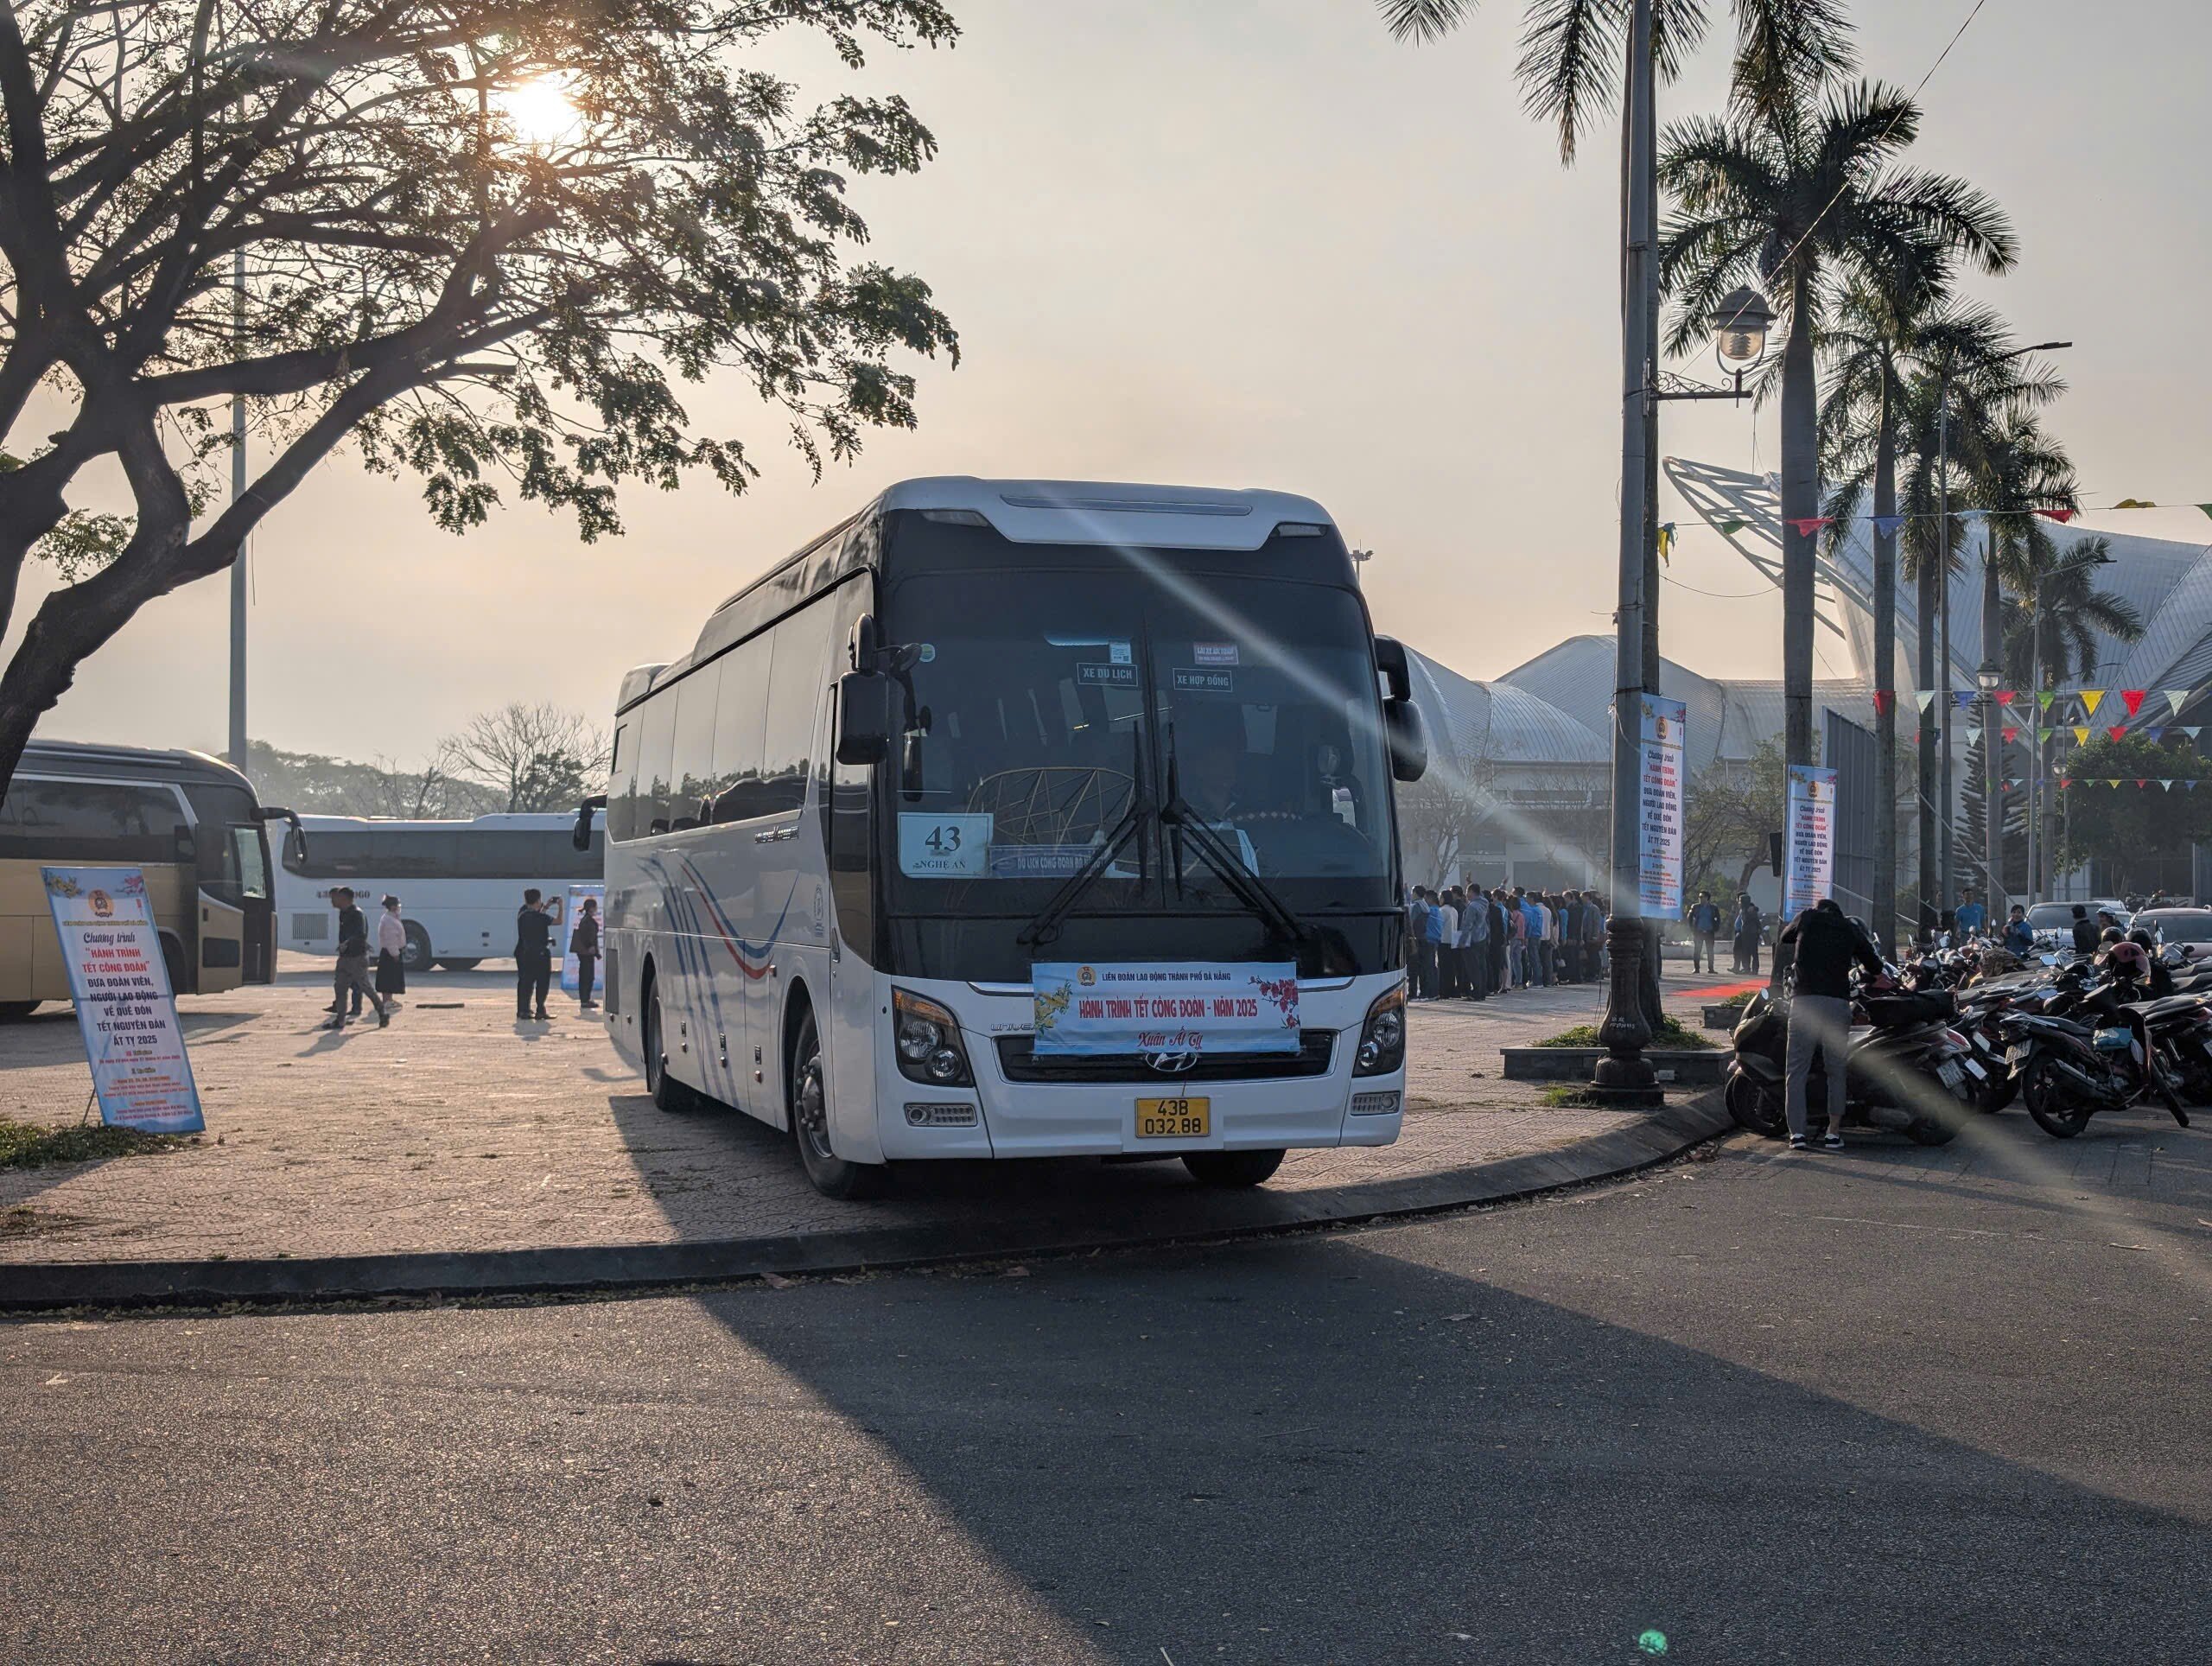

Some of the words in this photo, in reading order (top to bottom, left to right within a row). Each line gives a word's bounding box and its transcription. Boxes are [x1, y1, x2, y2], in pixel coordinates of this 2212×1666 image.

[1084, 668, 1095, 677] XE
[1097, 669, 1109, 678] DU
[1113, 669, 1132, 681] LỊCH
[1177, 675, 1187, 684] XE
[1190, 675, 1205, 687] HỢP
[925, 826, 961, 851] 43
[1660, 838, 1670, 847] 2025
[921, 859, 950, 870] NGHỆ
[84, 932, 114, 945] Chương
[118, 932, 136, 943] trình
[116, 947, 141, 957] TRÌNH
[82, 961, 97, 973] TẾT
[99, 962, 122, 972] CÔNG
[87, 978, 105, 988] ĐƯA
[107, 976, 130, 987] ĐOÀN
[131, 976, 154, 988] VIÊN,
[1103, 971, 1116, 982] LIÊN
[1117, 971, 1135, 982] ĐOÀN
[1136, 973, 1148, 982] LAO
[1150, 971, 1166, 982] ĐỘNG
[1168, 971, 1188, 981] THÀNH
[1190, 970, 1202, 981] PHỐ
[1204, 971, 1212, 981] ĐÀ
[90, 990, 117, 1002] NGƯỜI
[118, 992, 134, 1002] LAO
[136, 989, 158, 1002] ĐỘNG
[104, 1005, 115, 1017] VỀ
[117, 1005, 133, 1017] QUÊ
[135, 1005, 152, 1015] ĐÓN
[1079, 996, 1103, 1019] HÀNH
[1106, 995, 1132, 1018] TRÌNH
[1134, 993, 1148, 1018] TẾT
[1152, 995, 1177, 1017] CÔNG
[1179, 995, 1205, 1017] ĐOÀN
[1213, 995, 1234, 1017] NĂM
[1236, 999, 1258, 1017] 2025
[97, 1021, 111, 1032] TẾT
[113, 1020, 147, 1030] NGUYÊN
[149, 1019, 166, 1029] ĐÁN
[114, 1033, 123, 1046] ẤT
[125, 1036, 135, 1046] TỴ
[138, 1035, 157, 1044] 2025
[1138, 1032, 1166, 1047] Xuân
[1157, 1100, 1189, 1116] 43B
[1145, 1118, 1202, 1134] 032.88
